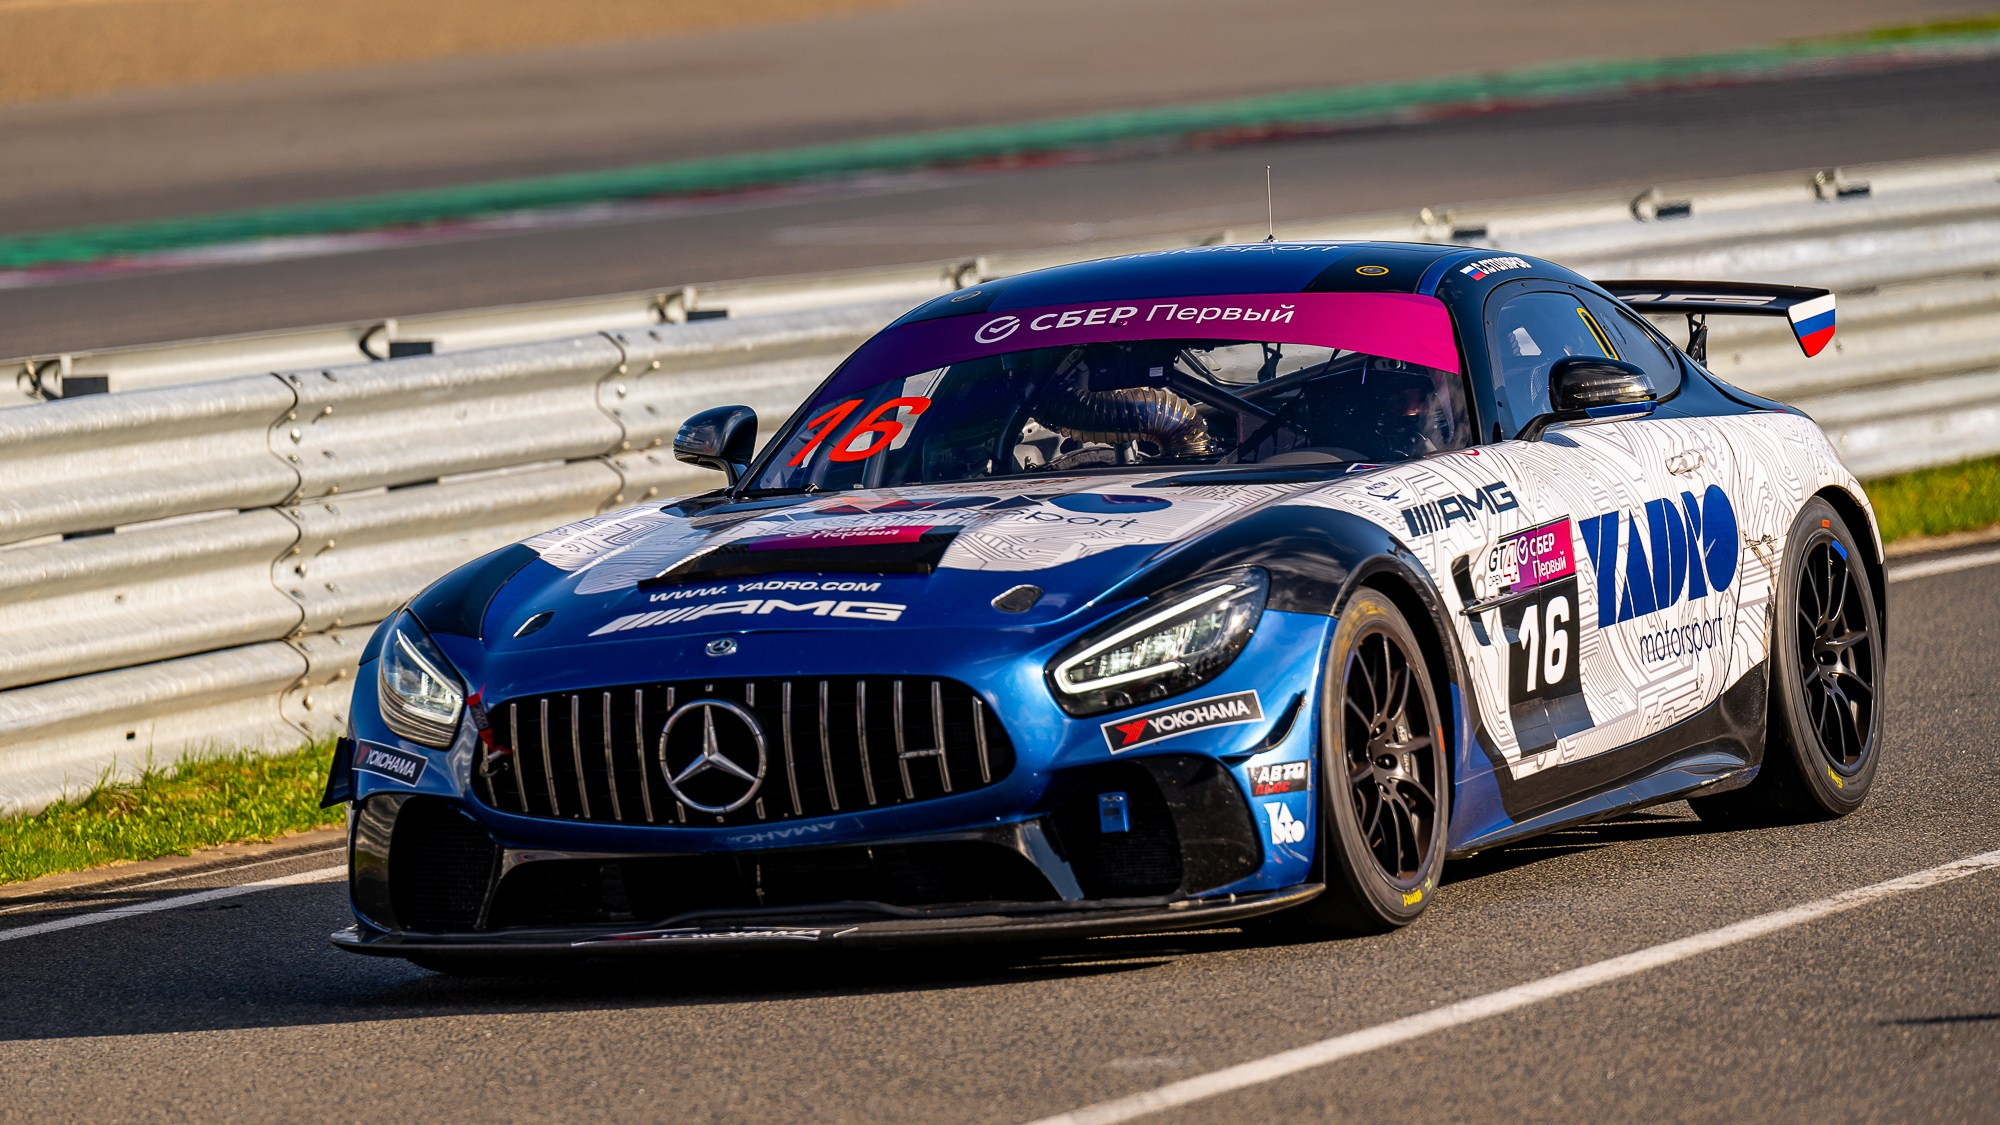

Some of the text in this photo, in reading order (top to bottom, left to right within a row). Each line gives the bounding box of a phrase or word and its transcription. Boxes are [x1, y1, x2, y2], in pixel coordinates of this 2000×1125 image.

[1029, 303, 1295, 331] СБЕР Первый
[786, 396, 932, 467] 16
[1437, 480, 1520, 529] AMG
[1488, 538, 1518, 583] GT4
[1529, 532, 1555, 557] СБЕР
[1532, 550, 1567, 579] Первый
[1577, 483, 1739, 630] YADRO
[736, 581, 882, 593] YADRO.COM
[1517, 595, 1571, 693] 16
[1640, 607, 1724, 665] motorsport
[1147, 699, 1251, 734] YOKOHAMA
[366, 748, 417, 778] YOKOHAMA
